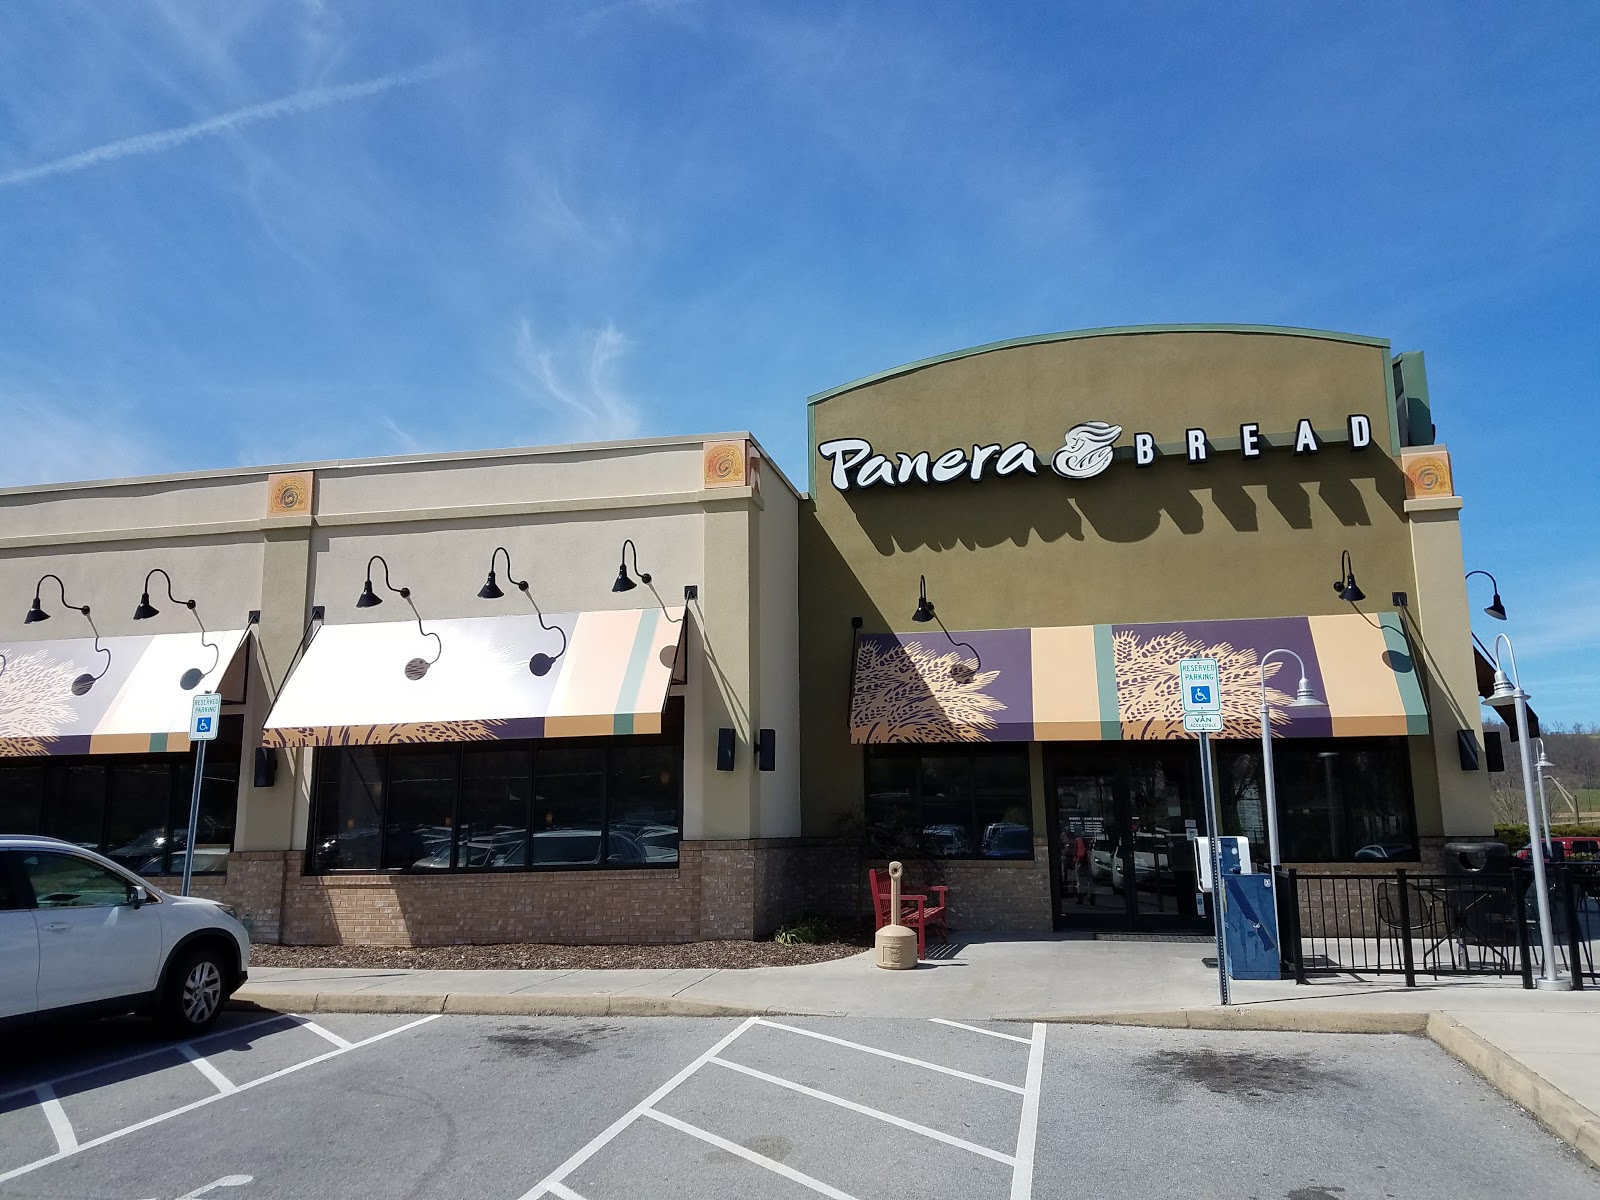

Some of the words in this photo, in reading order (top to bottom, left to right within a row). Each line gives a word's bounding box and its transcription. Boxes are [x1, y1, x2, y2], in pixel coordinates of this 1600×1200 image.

[819, 438, 1038, 491] Panera
[1134, 413, 1372, 466] BREAD
[1185, 673, 1214, 681] PARKING
